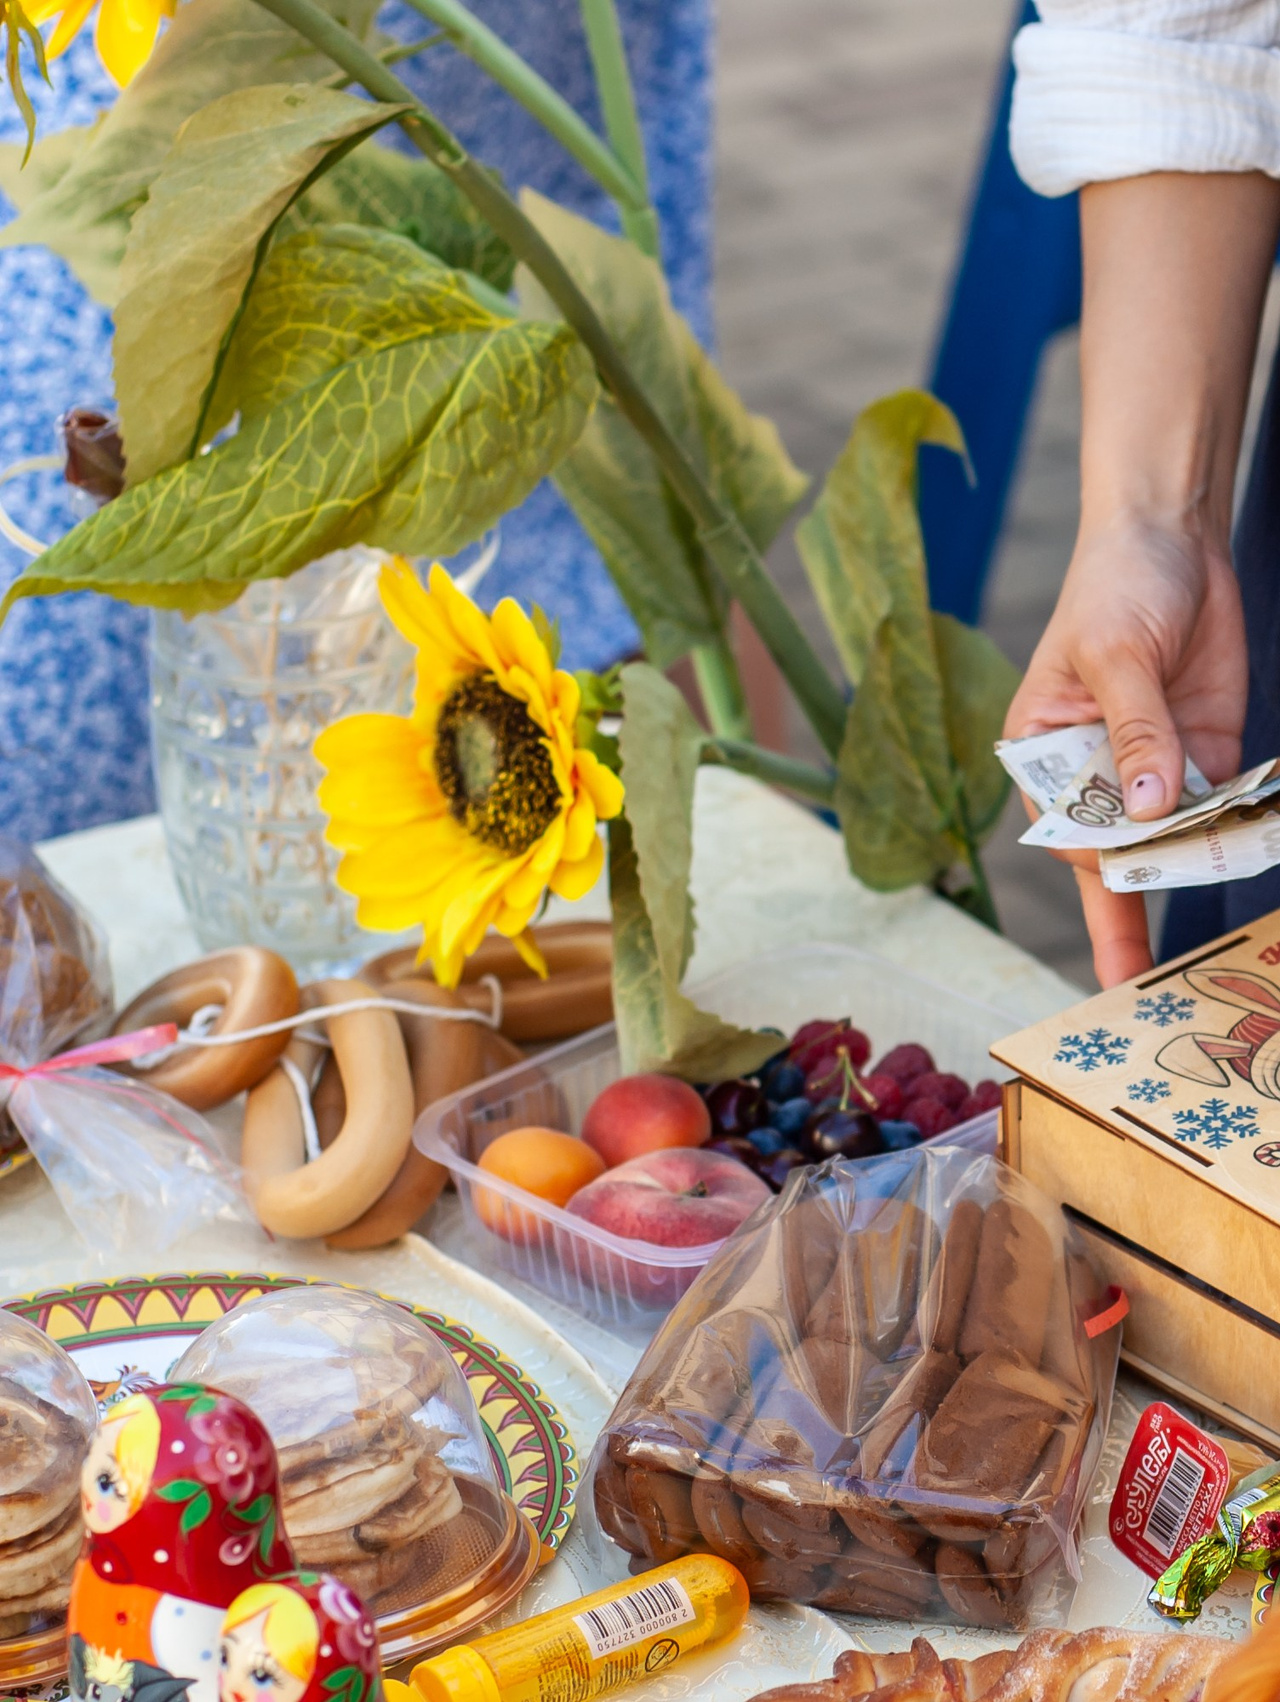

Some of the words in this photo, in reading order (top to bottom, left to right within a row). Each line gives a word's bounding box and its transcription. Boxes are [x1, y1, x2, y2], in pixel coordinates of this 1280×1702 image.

[1176, 1526, 1190, 1553] МАССА
[1188, 1500, 1202, 1526] НЕТТО
[640, 1613, 678, 1634] 800000
[682, 1608, 688, 1618] 2
[597, 1629, 636, 1652] 327750
